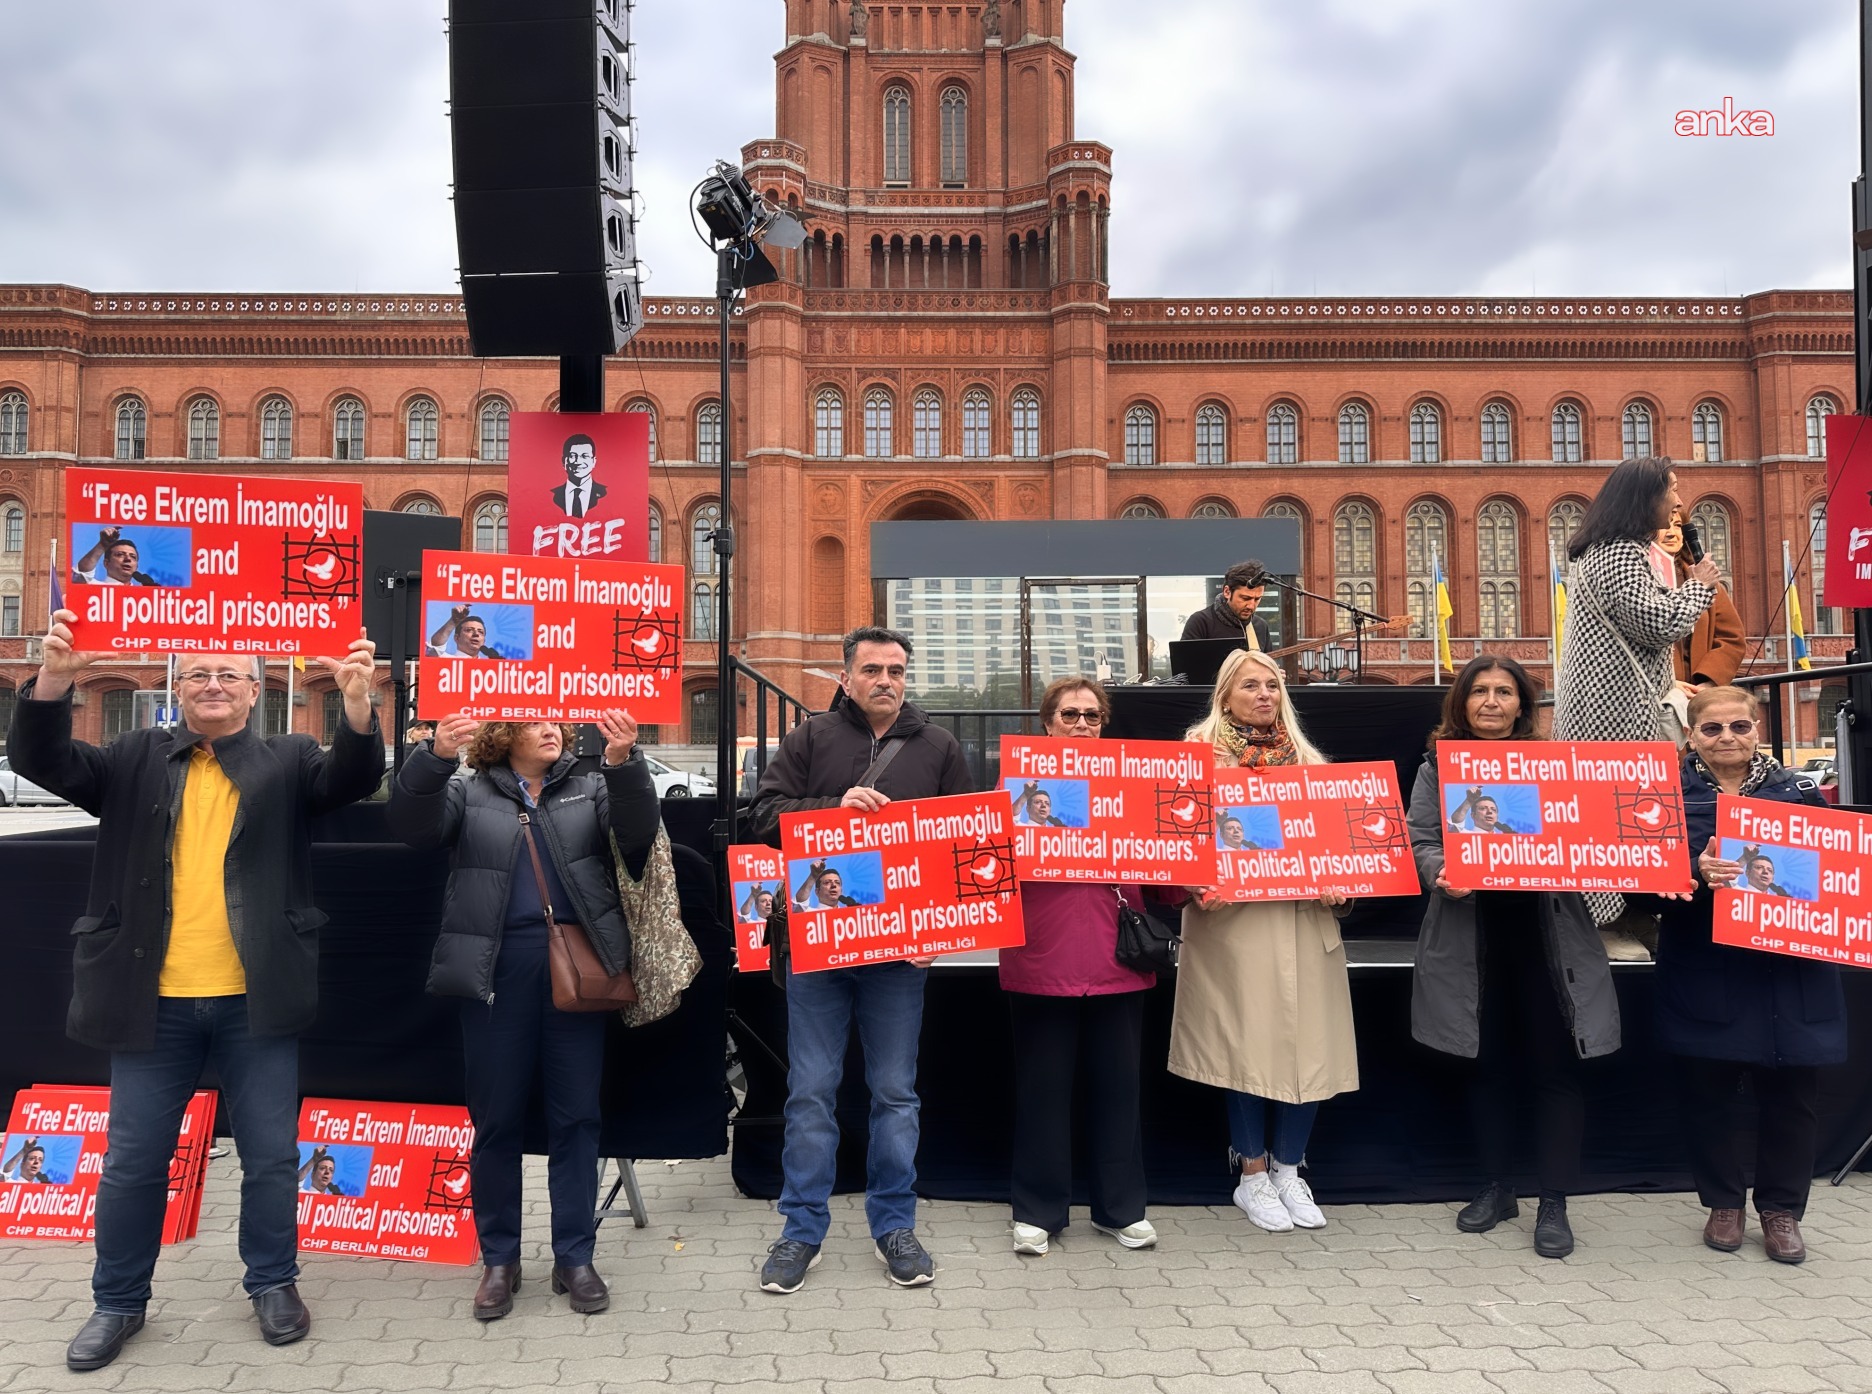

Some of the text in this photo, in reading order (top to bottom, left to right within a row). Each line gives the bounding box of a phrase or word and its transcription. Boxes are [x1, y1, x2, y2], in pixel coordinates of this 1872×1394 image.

[82, 483, 348, 538] “Free Ekrem İmamoğlu
[533, 519, 625, 558] FREE
[196, 541, 239, 576] and
[437, 564, 671, 615] “Free Ekrem İmamoğlu
[87, 587, 348, 634] all political prisoners.”
[111, 637, 300, 652] CHP BERLİN BİRLİĞİ
[537, 617, 575, 649] and
[438, 661, 670, 703] all political prisoners.”
[460, 706, 496, 717] CHP
[502, 706, 563, 718] BERLİN
[1012, 744, 1203, 786] “Free Ekrem İmamoğlu
[1450, 746, 1667, 789] “Free Ekrem İmamoğlu
[1092, 790, 1123, 818] and
[1214, 770, 1389, 804] ree Ekrem İmamoğlu
[1284, 812, 1316, 838] and
[1544, 795, 1580, 823] and
[793, 806, 1002, 854] “Free Ekrem İmamoğlu
[1730, 807, 1782, 841] “Free
[1789, 815, 1851, 852] Ekrem
[1015, 828, 1206, 866] all political prisoners.”
[1461, 836, 1676, 874] all political prisoners.”
[737, 854, 775, 878] “Free
[887, 857, 920, 890] and
[1033, 868, 1171, 881] CHP BERLİN BİRLİĞİ
[1238, 851, 1306, 885] political
[1309, 847, 1402, 882] prisoners.”
[1482, 877, 1639, 889] CHP BERLİN BİRLİĞİ
[1823, 867, 1859, 896] and
[1235, 889, 1263, 898] CHP
[1267, 886, 1319, 897] BERLİN
[806, 892, 1010, 948] all political prisoners.”
[1731, 894, 1754, 922] all
[1760, 900, 1838, 936] political
[828, 937, 976, 965] CHP BERLİN BİRLİĞİ
[1751, 936, 1784, 948] CHP
[1789, 942, 1849, 959] BERLİN
[22, 1103, 60, 1131] “Free
[309, 1109, 350, 1140] “Free
[352, 1112, 404, 1144] Ekrem
[370, 1159, 404, 1188] and
[0, 1185, 20, 1214] all
[17, 1186, 86, 1221] political
[311, 1197, 379, 1234] political
[377, 1202, 470, 1239] prisoners.”
[6, 1226, 34, 1236] CHP
[36, 1226, 84, 1237] BERLİN
[301, 1238, 429, 1258] CHP BERLİN BİRLİĞİ
